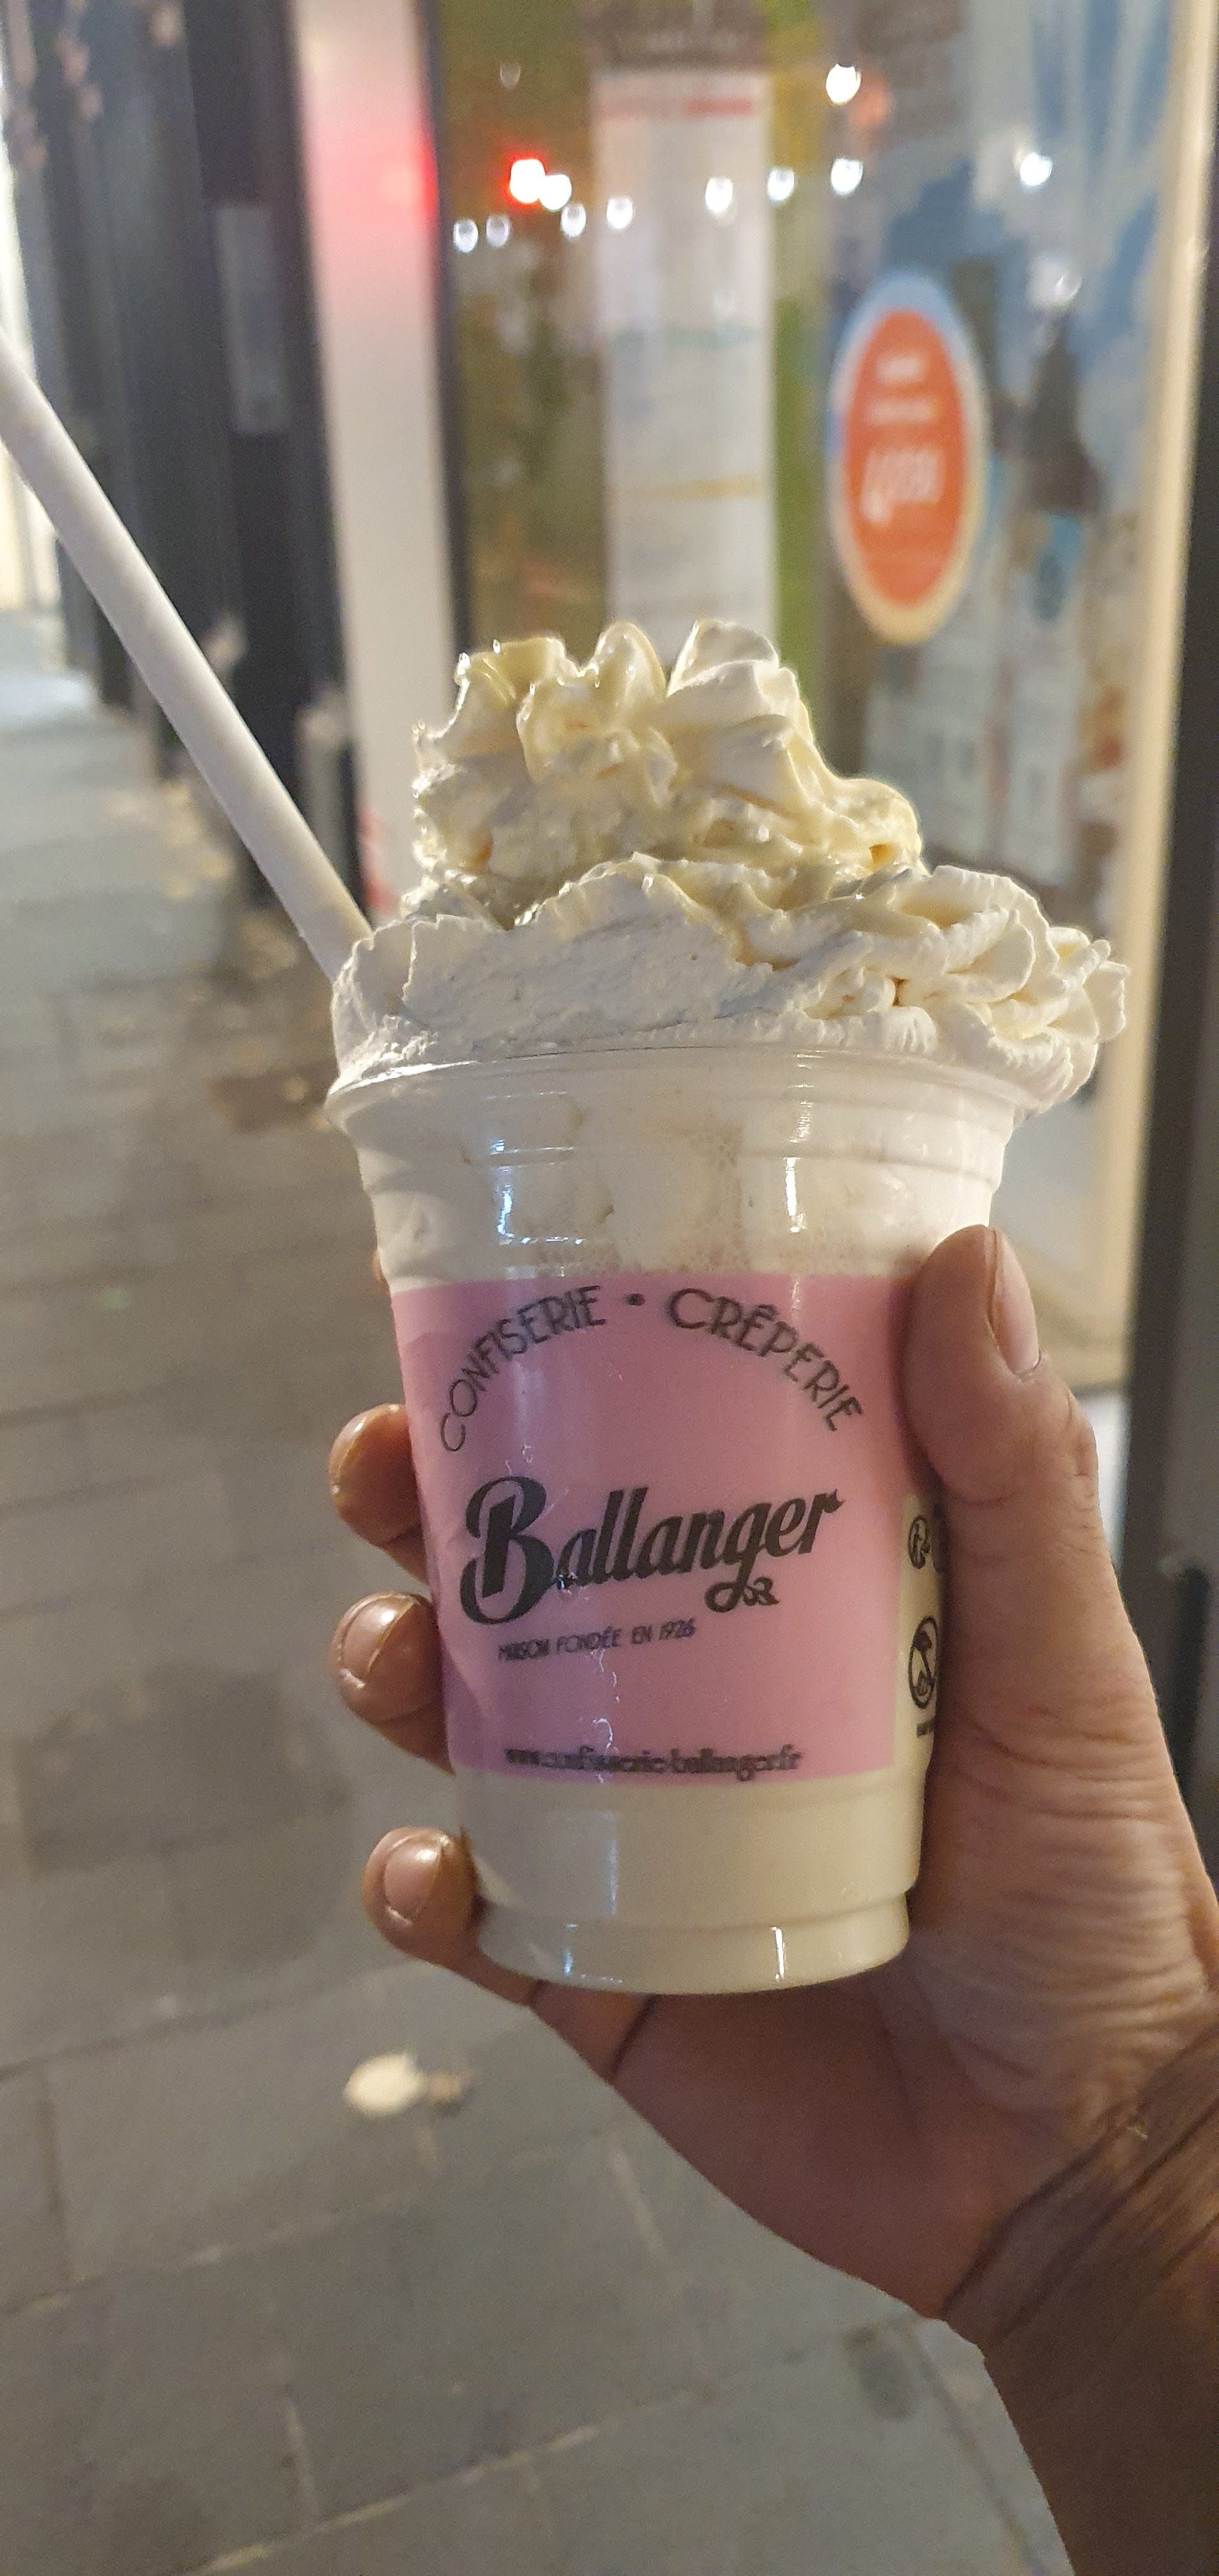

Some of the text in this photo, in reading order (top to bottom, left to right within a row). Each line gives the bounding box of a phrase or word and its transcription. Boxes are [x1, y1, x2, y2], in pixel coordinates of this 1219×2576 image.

[441, 1285, 864, 1452] CONFISERIE CRÊPERIE
[459, 1476, 845, 1625] Ballanger
[497, 1617, 696, 1662] MAISON FONDÉE EN 1926
